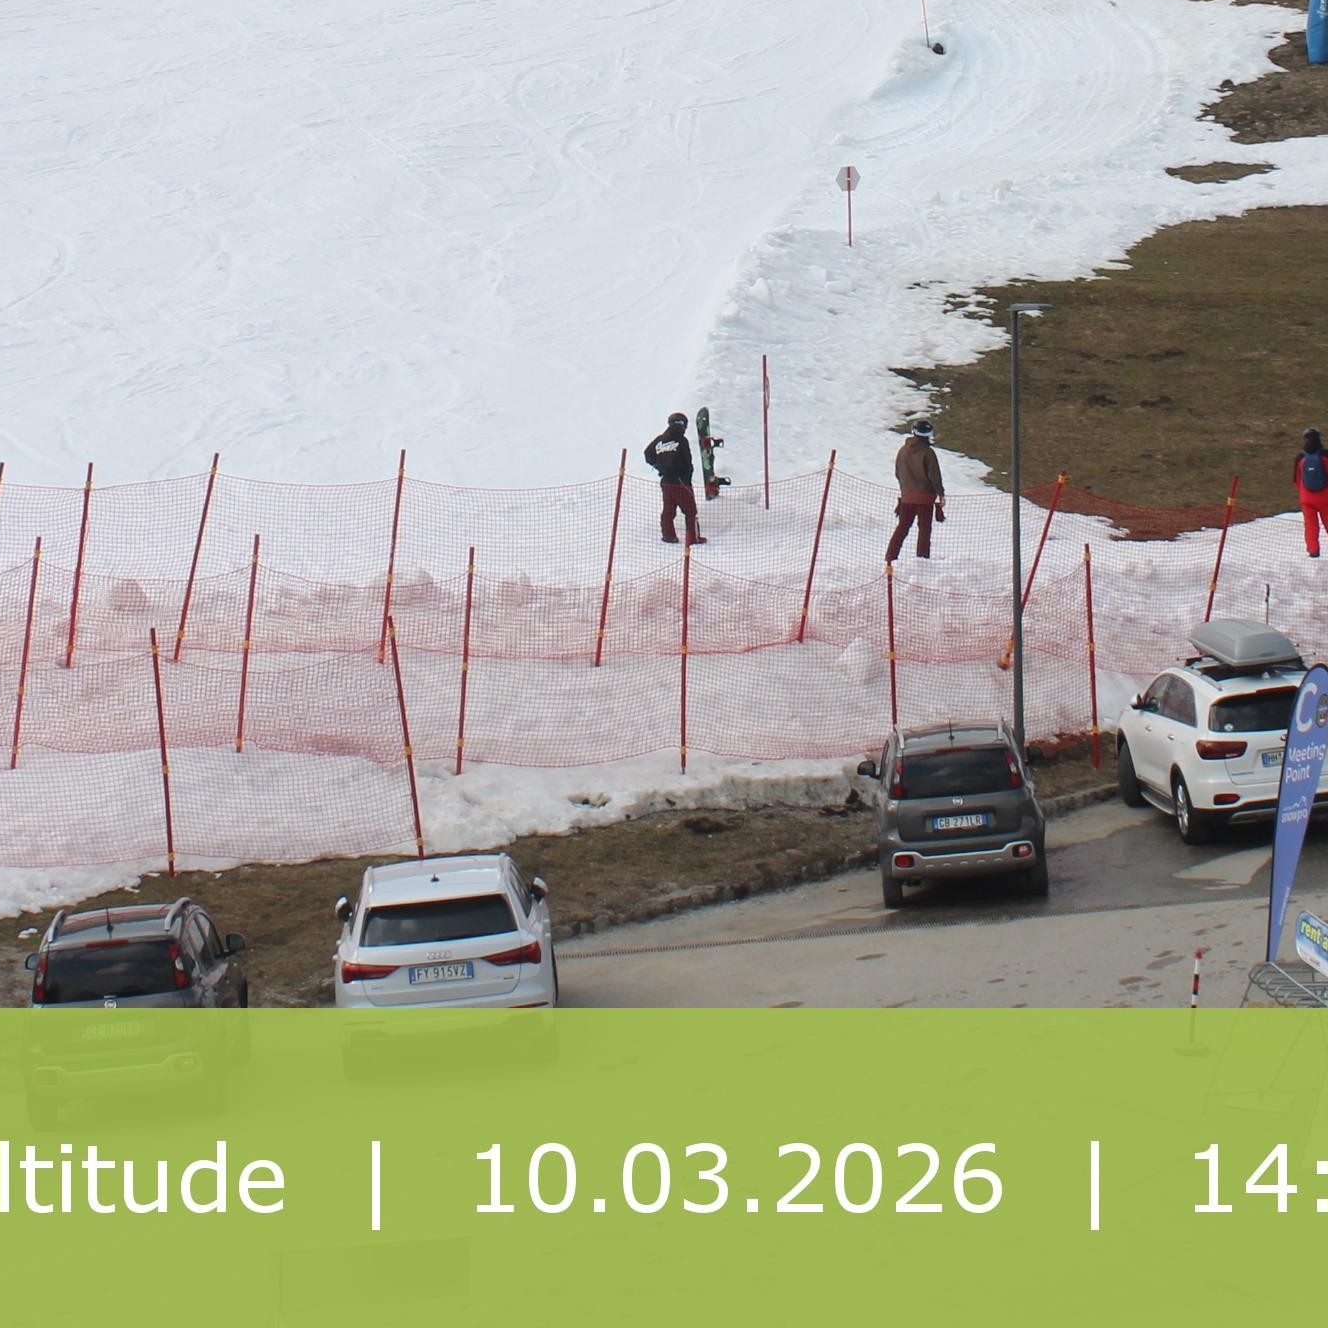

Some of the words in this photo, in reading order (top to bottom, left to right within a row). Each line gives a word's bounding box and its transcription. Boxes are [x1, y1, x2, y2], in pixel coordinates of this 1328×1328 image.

[1288, 742, 1326, 764] Meeting
[1285, 764, 1311, 783] Point
[1300, 920, 1321, 945] rent
[416, 967, 430, 980] FY
[433, 964, 466, 978] 915VZ
